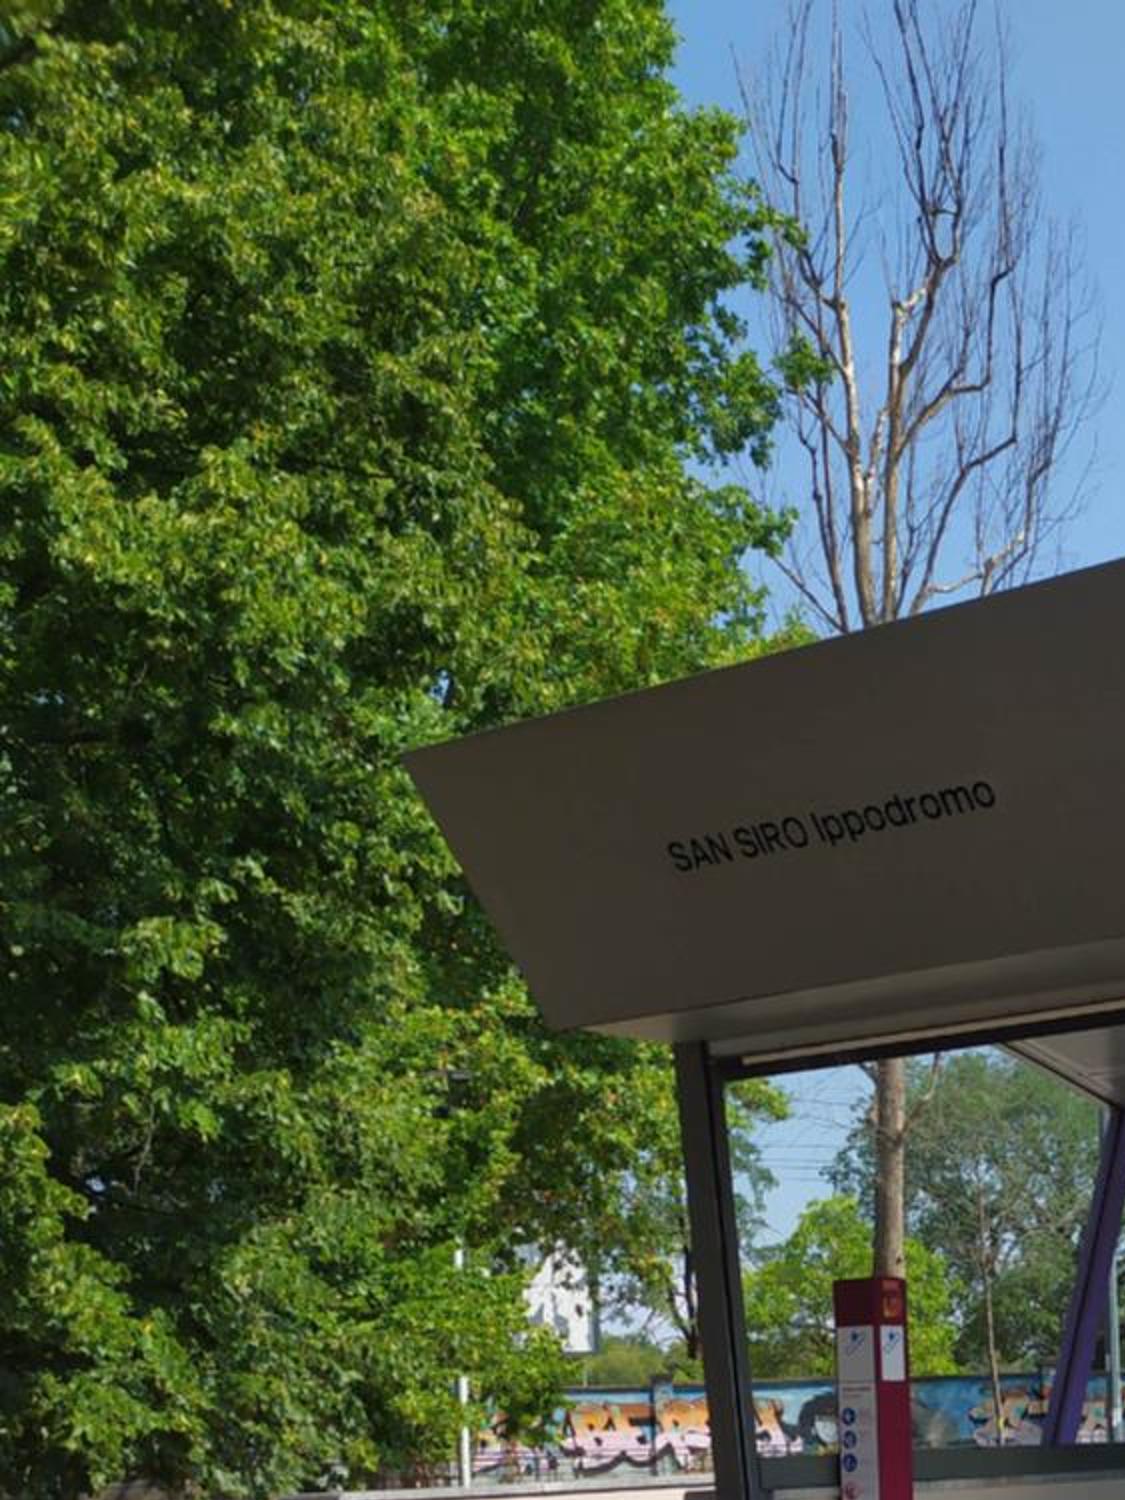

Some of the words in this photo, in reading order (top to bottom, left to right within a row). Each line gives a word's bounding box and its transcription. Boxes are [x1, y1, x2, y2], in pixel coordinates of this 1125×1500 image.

[667, 832, 735, 872] SAN
[733, 816, 809, 859] SIRO
[809, 780, 996, 847] Ippodromo
